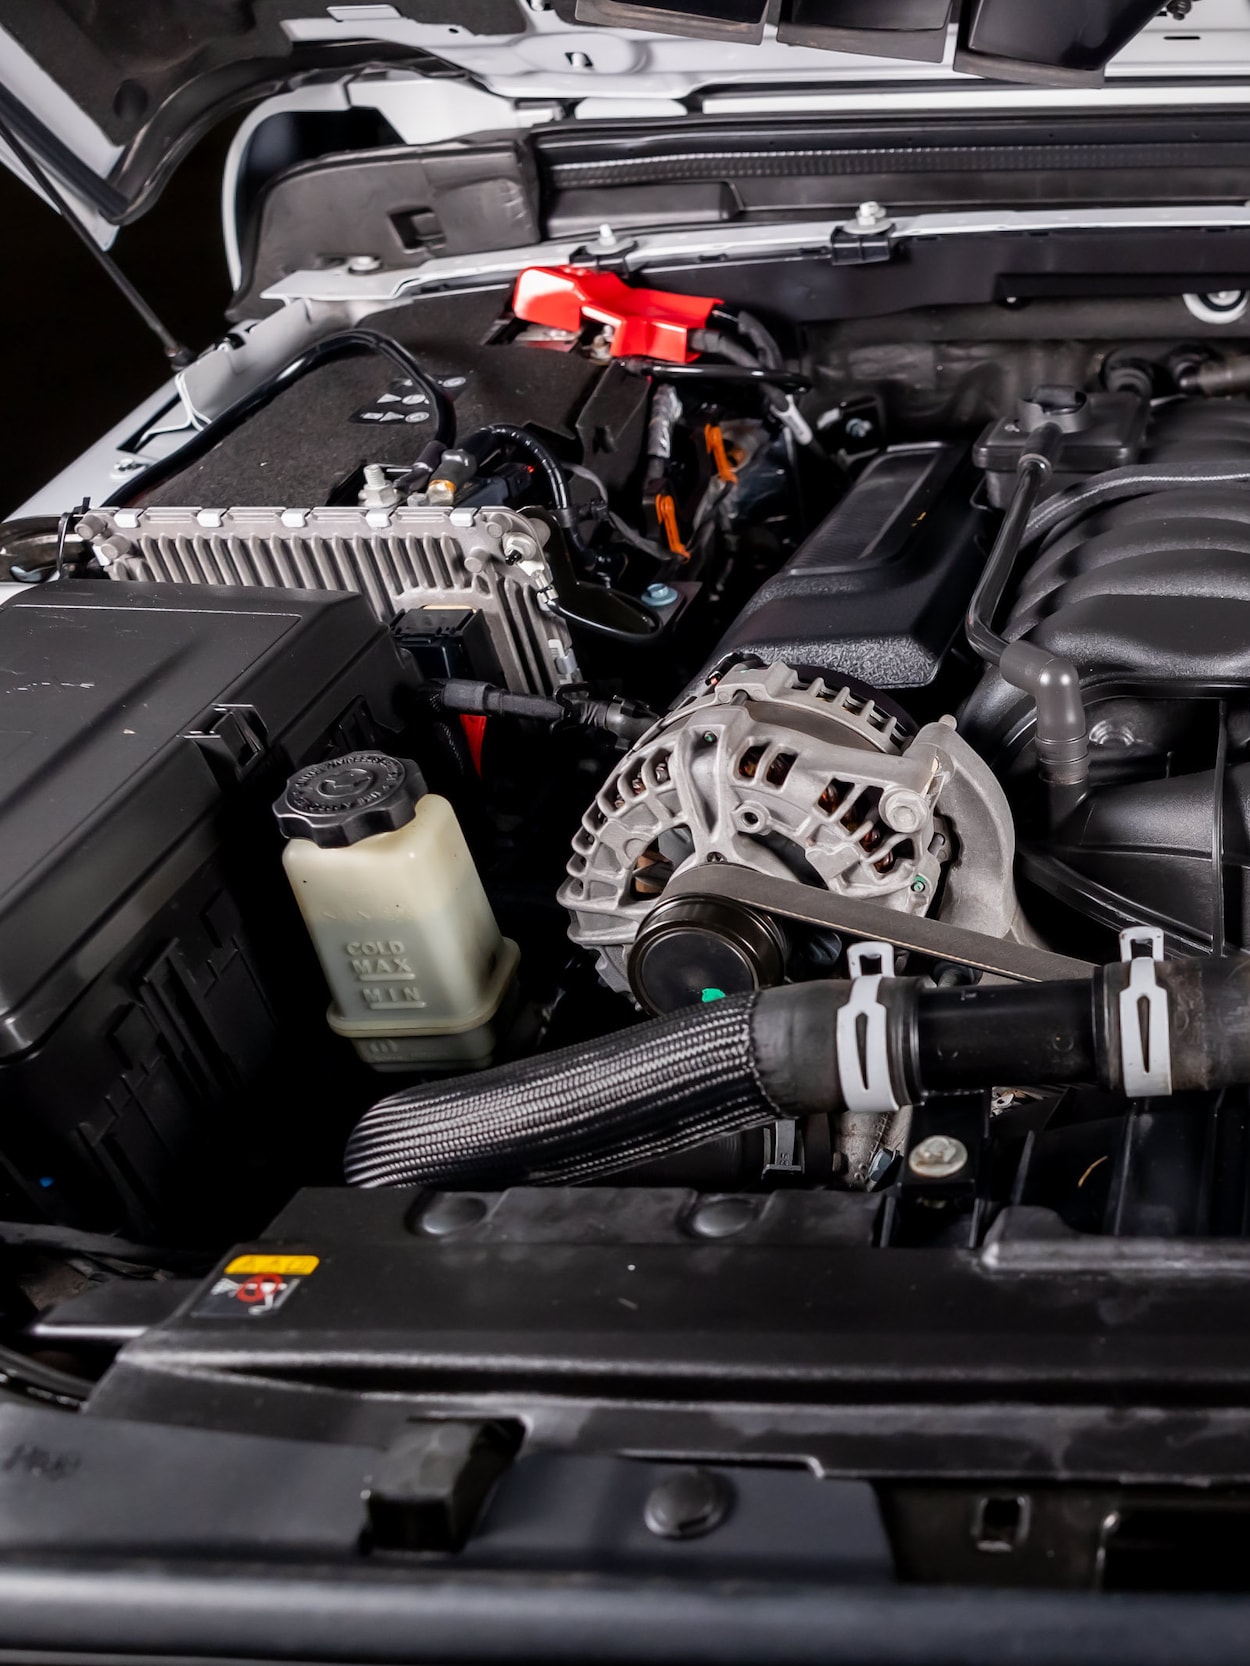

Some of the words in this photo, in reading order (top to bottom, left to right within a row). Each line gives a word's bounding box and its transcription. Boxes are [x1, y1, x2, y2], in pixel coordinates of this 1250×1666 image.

[346, 941, 405, 956] COLD
[351, 959, 412, 974] MAX
[363, 987, 420, 1002] MIN
